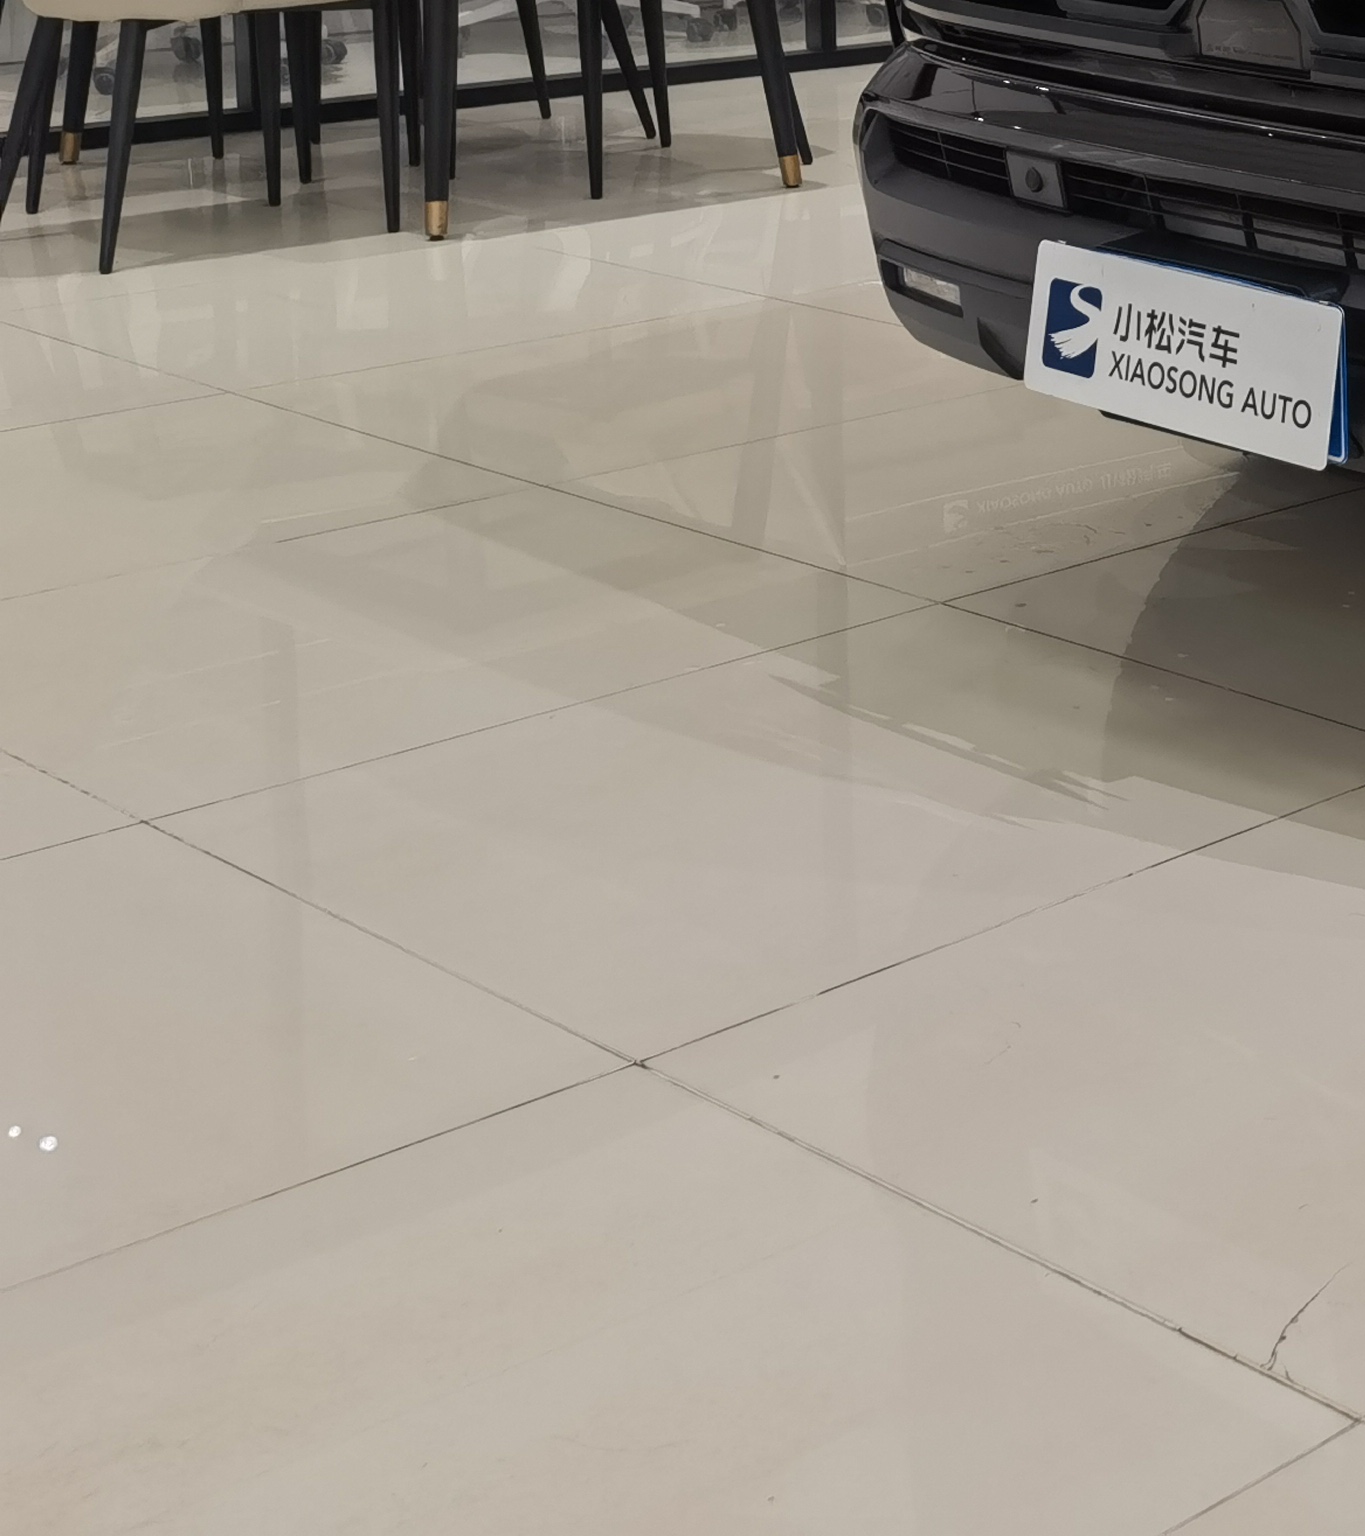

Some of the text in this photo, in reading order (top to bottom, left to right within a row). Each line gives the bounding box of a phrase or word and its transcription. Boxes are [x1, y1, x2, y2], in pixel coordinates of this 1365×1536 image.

[1112, 303, 1241, 369] 小松汽车
[1108, 350, 1312, 429] XIAOSONG AUTO
